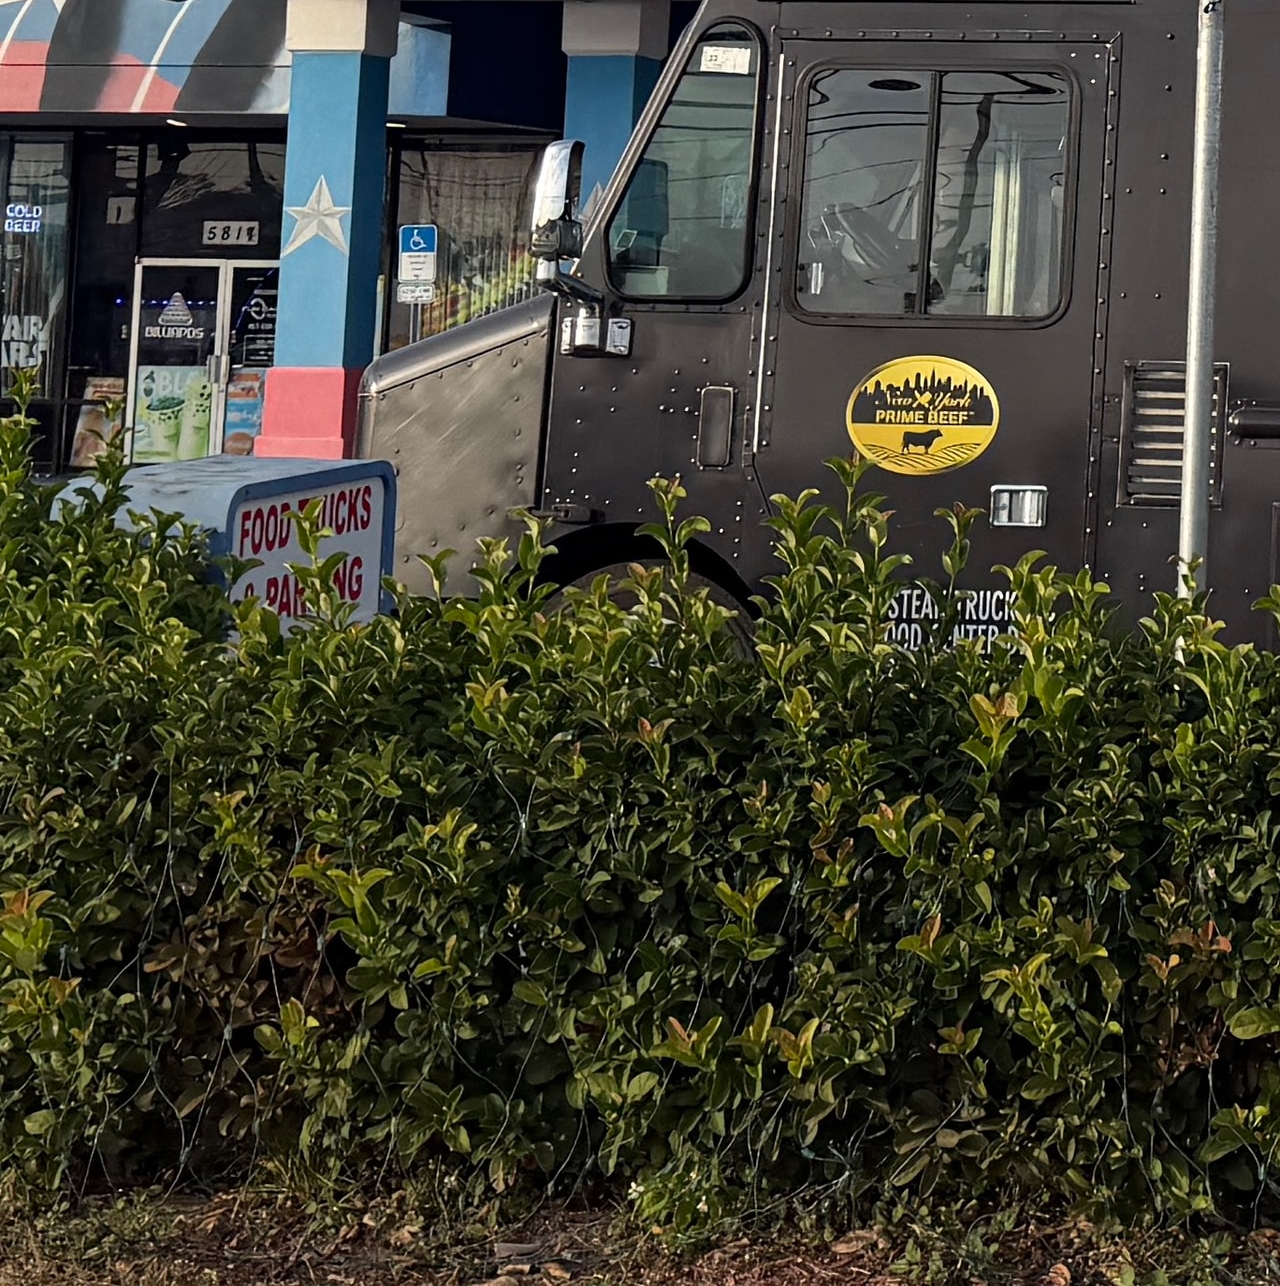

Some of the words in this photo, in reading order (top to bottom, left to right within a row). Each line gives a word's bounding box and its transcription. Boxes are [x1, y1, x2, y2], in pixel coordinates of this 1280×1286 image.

[6, 204, 42, 218] COLD
[4, 219, 41, 233] BEER
[876, 410, 924, 423] PRIME
[239, 502, 291, 557] FOOD
[298, 485, 372, 536] UCKS
